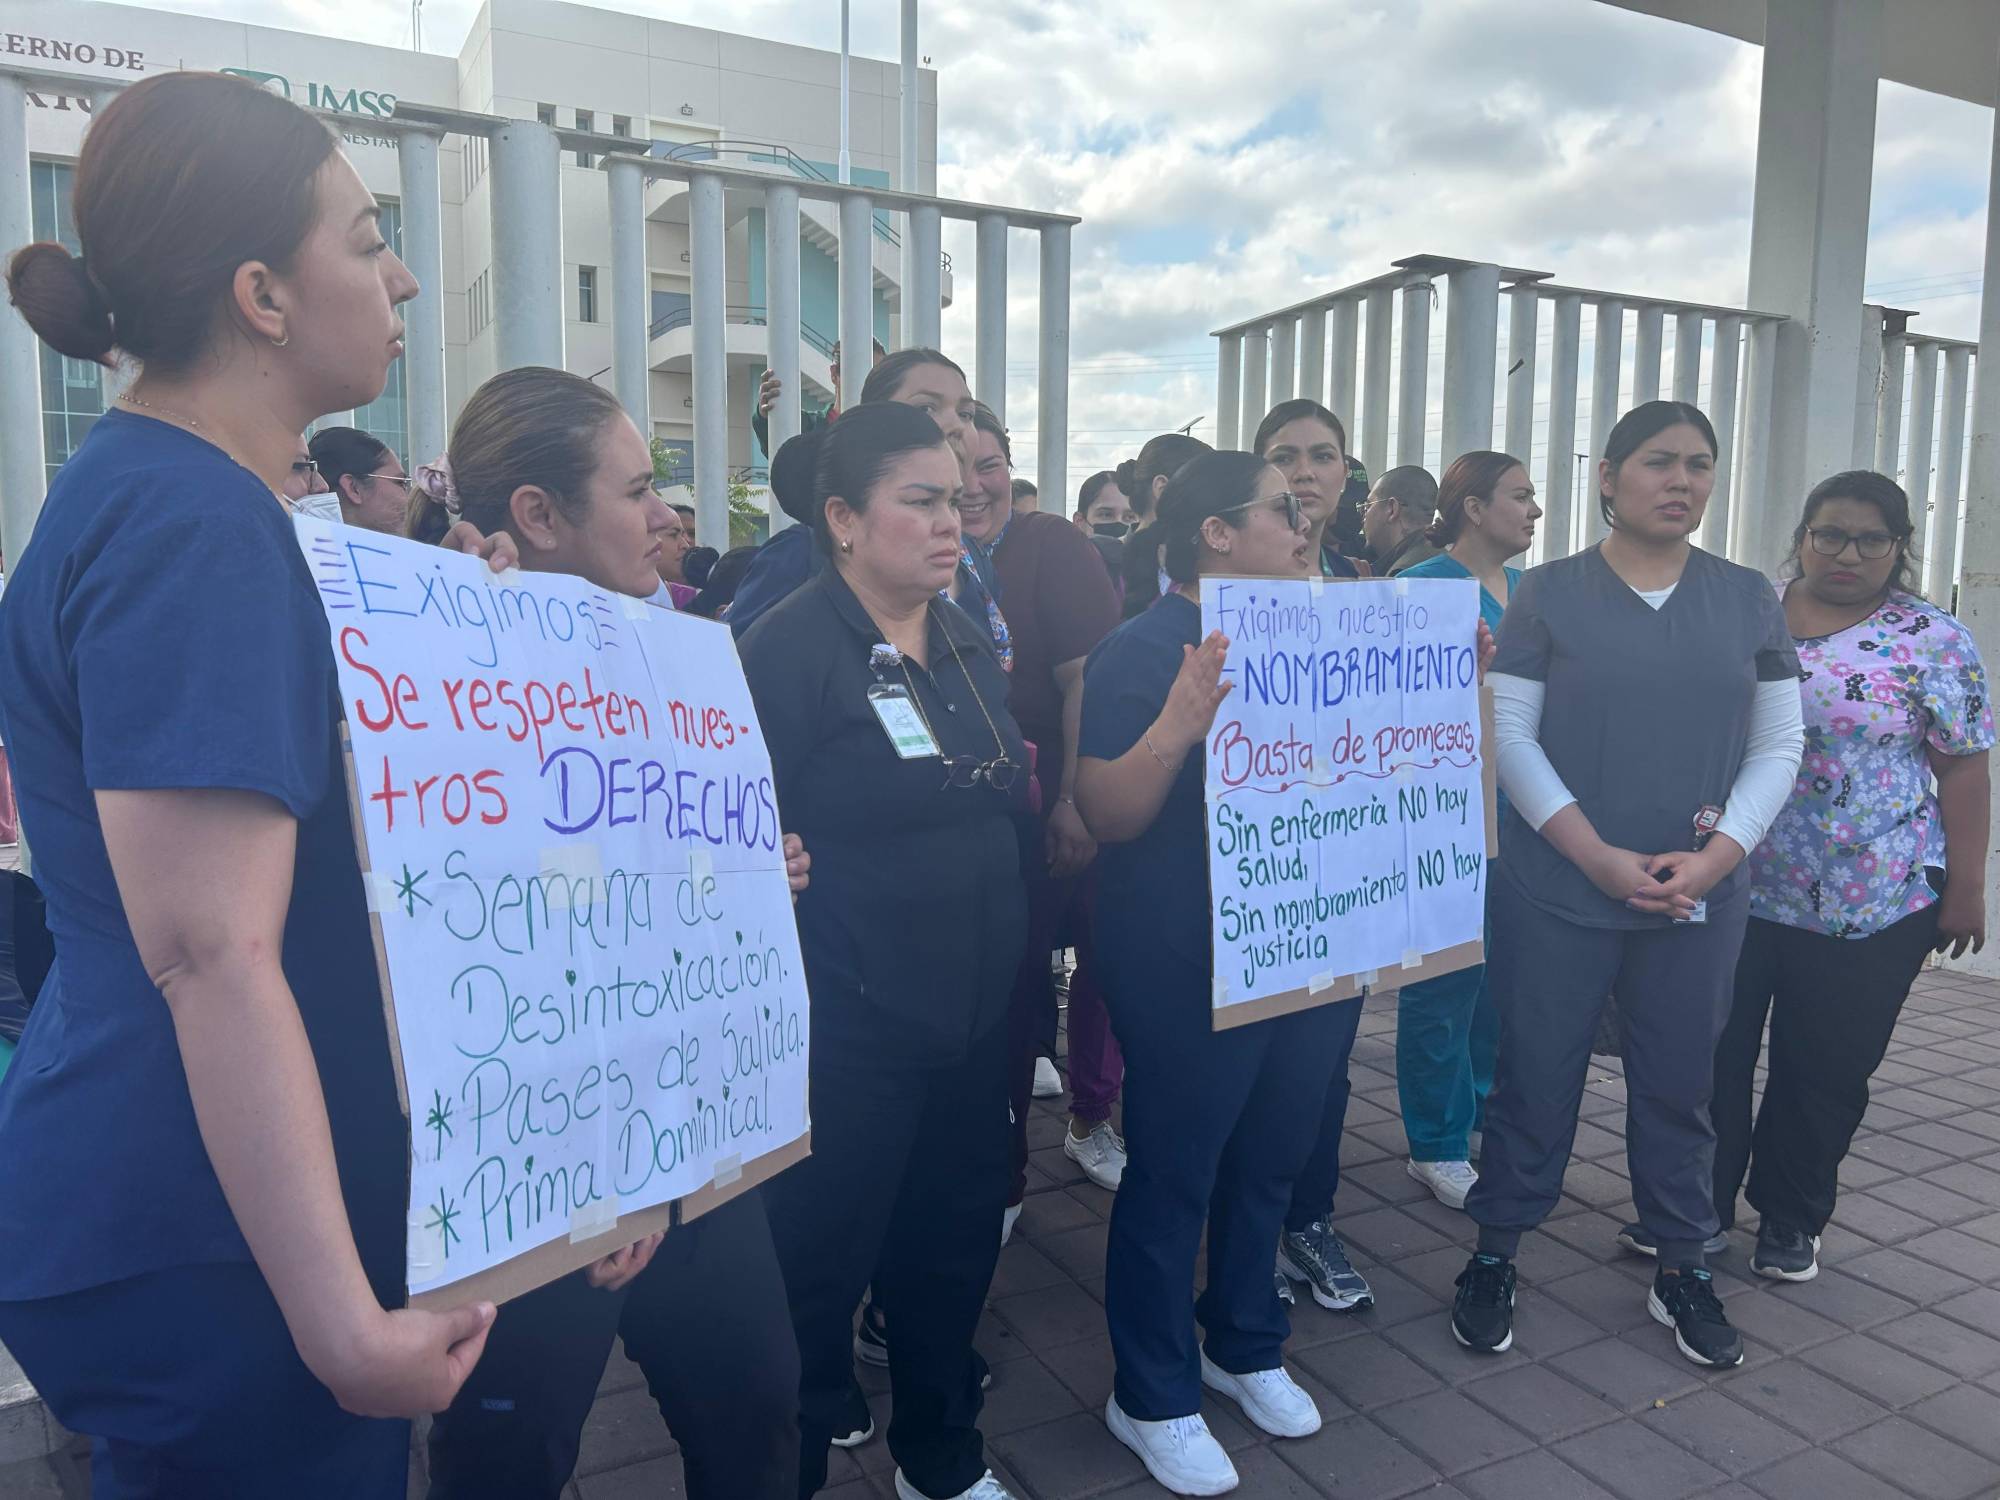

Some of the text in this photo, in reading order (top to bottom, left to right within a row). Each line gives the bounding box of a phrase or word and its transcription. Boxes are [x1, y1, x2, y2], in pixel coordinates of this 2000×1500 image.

[103, 47, 144, 71] DE
[308, 82, 396, 116] IMSS
[347, 541, 602, 668] Exigimos
[1339, 597, 1429, 638] nuestro
[340, 626, 428, 733] Se
[442, 667, 650, 763] respeten
[1244, 640, 1475, 713] NOMBRAMIENTO
[1213, 717, 1475, 787] Basta de promesas
[370, 746, 778, 852] tros DERECHOS
[1216, 803, 1262, 857] Sin
[1398, 786, 1428, 823] NO
[1435, 782, 1469, 825] hay
[444, 850, 724, 956] Semana de
[1220, 842, 1482, 942] Sin nombramiento NO hay
[1242, 924, 1328, 989] justicia
[462, 1057, 634, 1157] Pases
[657, 1029, 700, 1091] de
[463, 1154, 603, 1254] Prima
